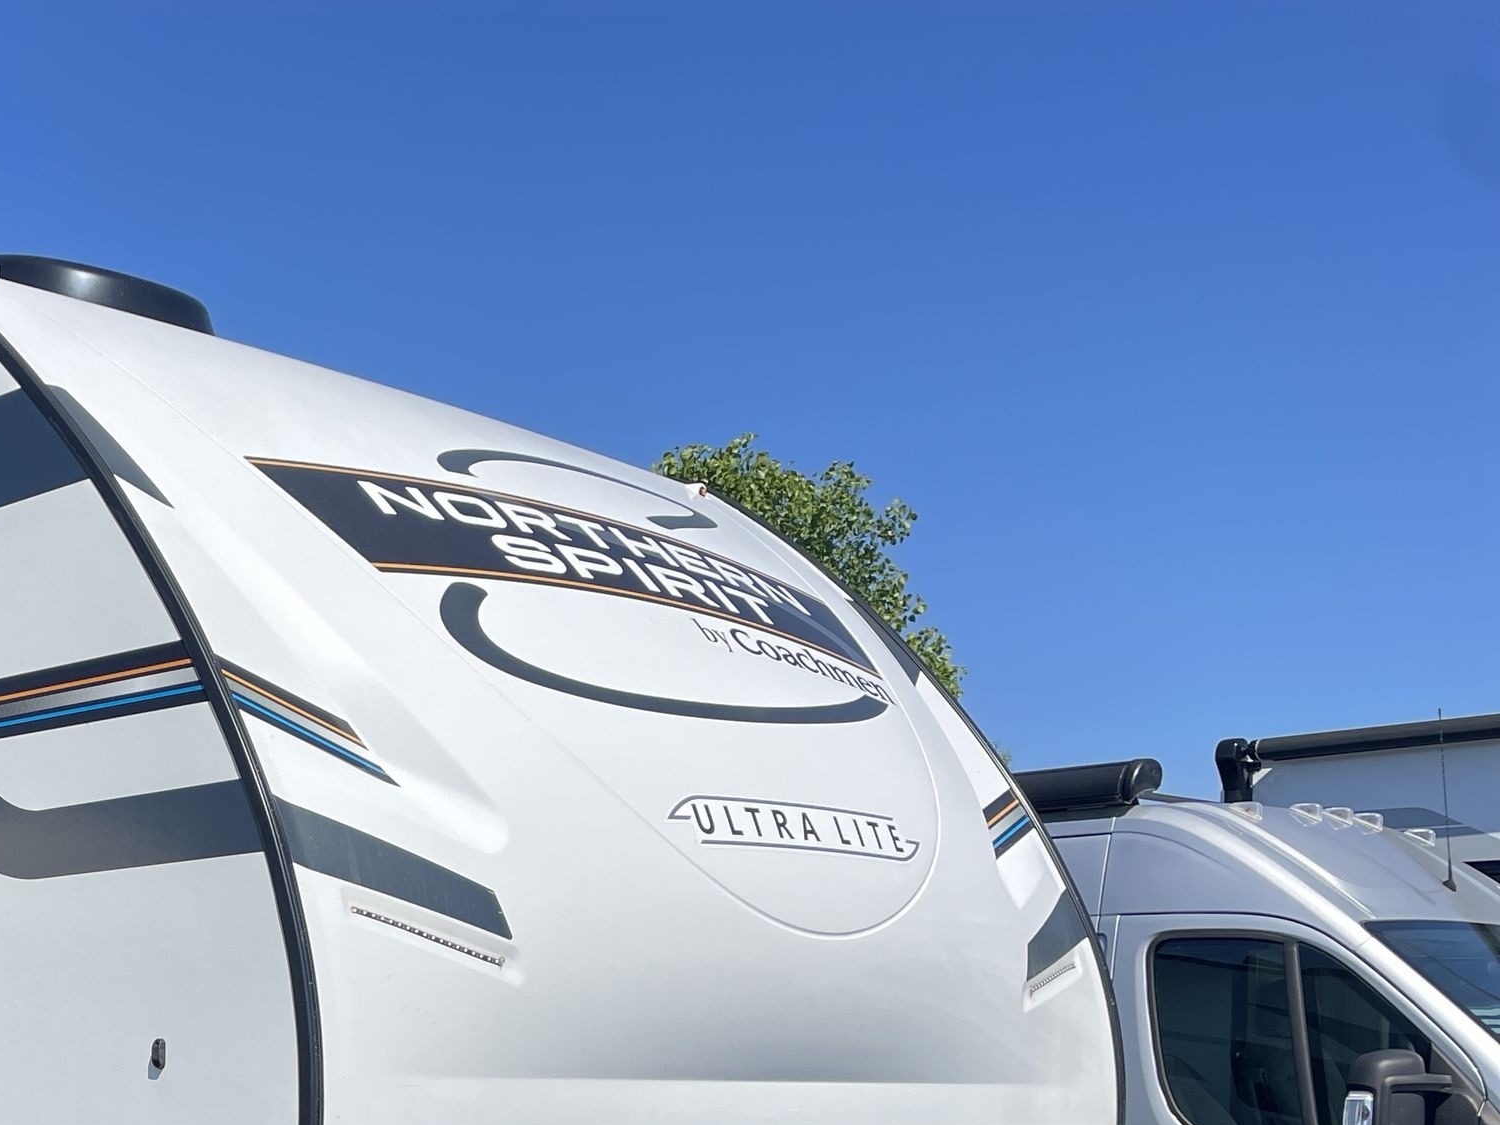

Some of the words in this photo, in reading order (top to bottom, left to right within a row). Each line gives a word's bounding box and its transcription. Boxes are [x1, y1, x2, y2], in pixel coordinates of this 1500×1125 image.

[357, 480, 812, 616] NORTHERN
[491, 534, 775, 625] SPIRIT
[690, 617, 733, 653] by
[729, 628, 898, 705] Coachmen
[691, 803, 821, 843] ULTRA
[833, 815, 904, 852] LITE
